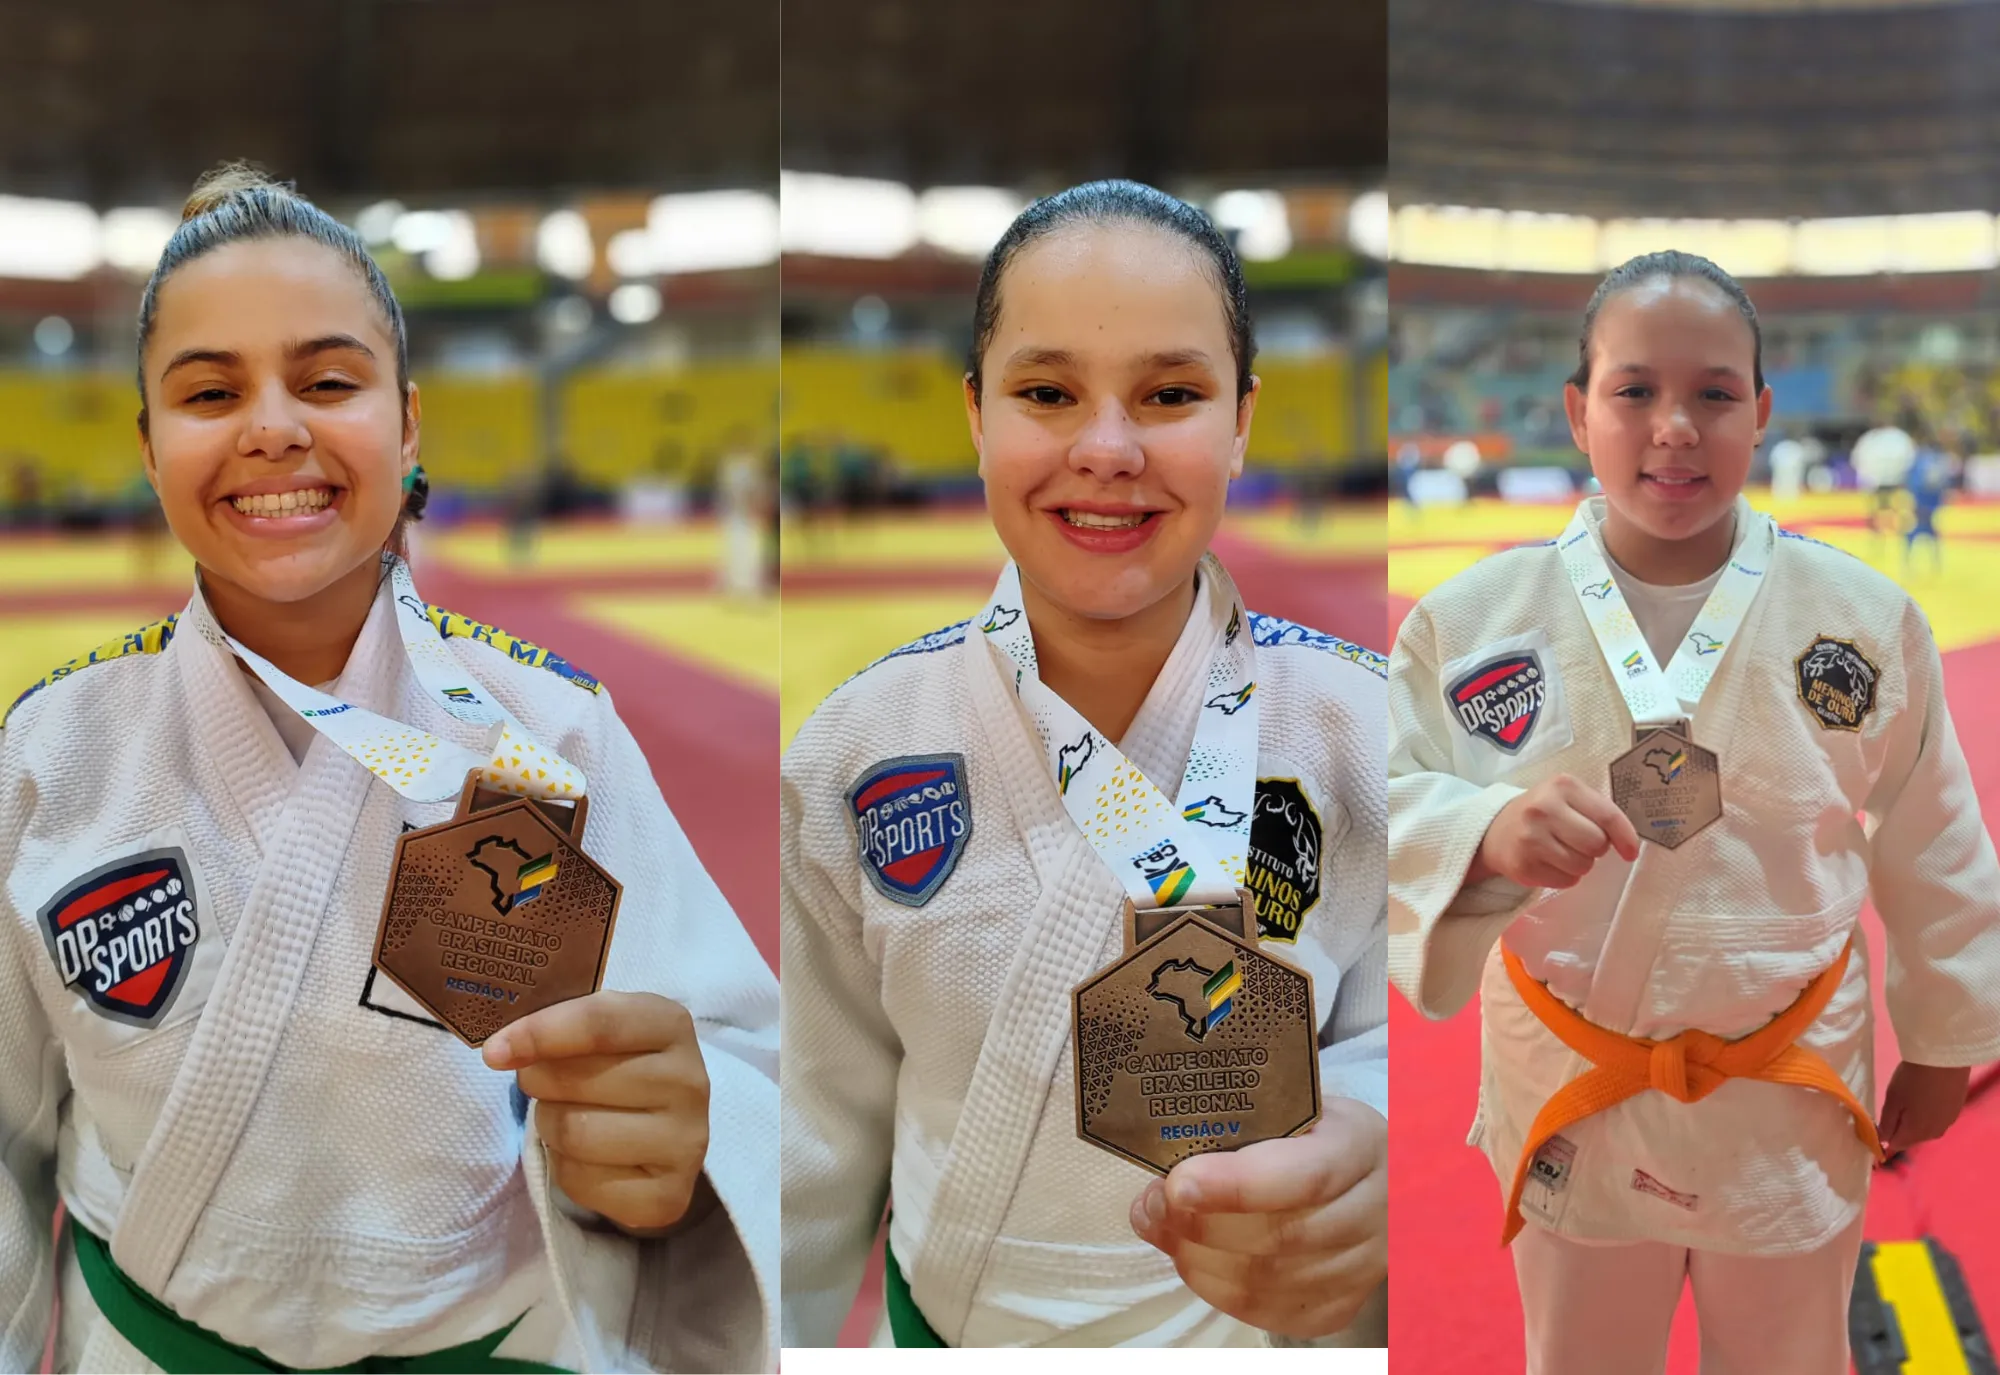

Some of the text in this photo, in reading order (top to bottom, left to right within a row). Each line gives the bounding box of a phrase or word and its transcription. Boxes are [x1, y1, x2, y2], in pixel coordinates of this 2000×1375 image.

[1458, 680, 1545, 734] DP SPORTS
[1808, 688, 1823, 706] DE
[1827, 699, 1856, 723] OURO
[1811, 679, 1856, 713] MENINOS
[858, 800, 965, 868] DP SPORTS
[1133, 844, 1178, 869] CBJ
[1248, 845, 1294, 879] STITUTO
[1245, 862, 1302, 912] NINOS
[430, 908, 562, 951] CAMPEONATO
[1254, 893, 1297, 932] URO
[55, 900, 198, 993] DP SPORTS
[438, 930, 549, 968] BRASILEIRO
[441, 951, 536, 986] REGIONAL
[508, 989, 519, 1004] V
[1125, 1047, 1268, 1074] CAMPEONATO
[1141, 1070, 1260, 1095] BRASILEIRO
[1150, 1093, 1254, 1117] REGIONAL
[1160, 1120, 1240, 1140] REGIÃO V
[1536, 1160, 1560, 1179] CBJ
